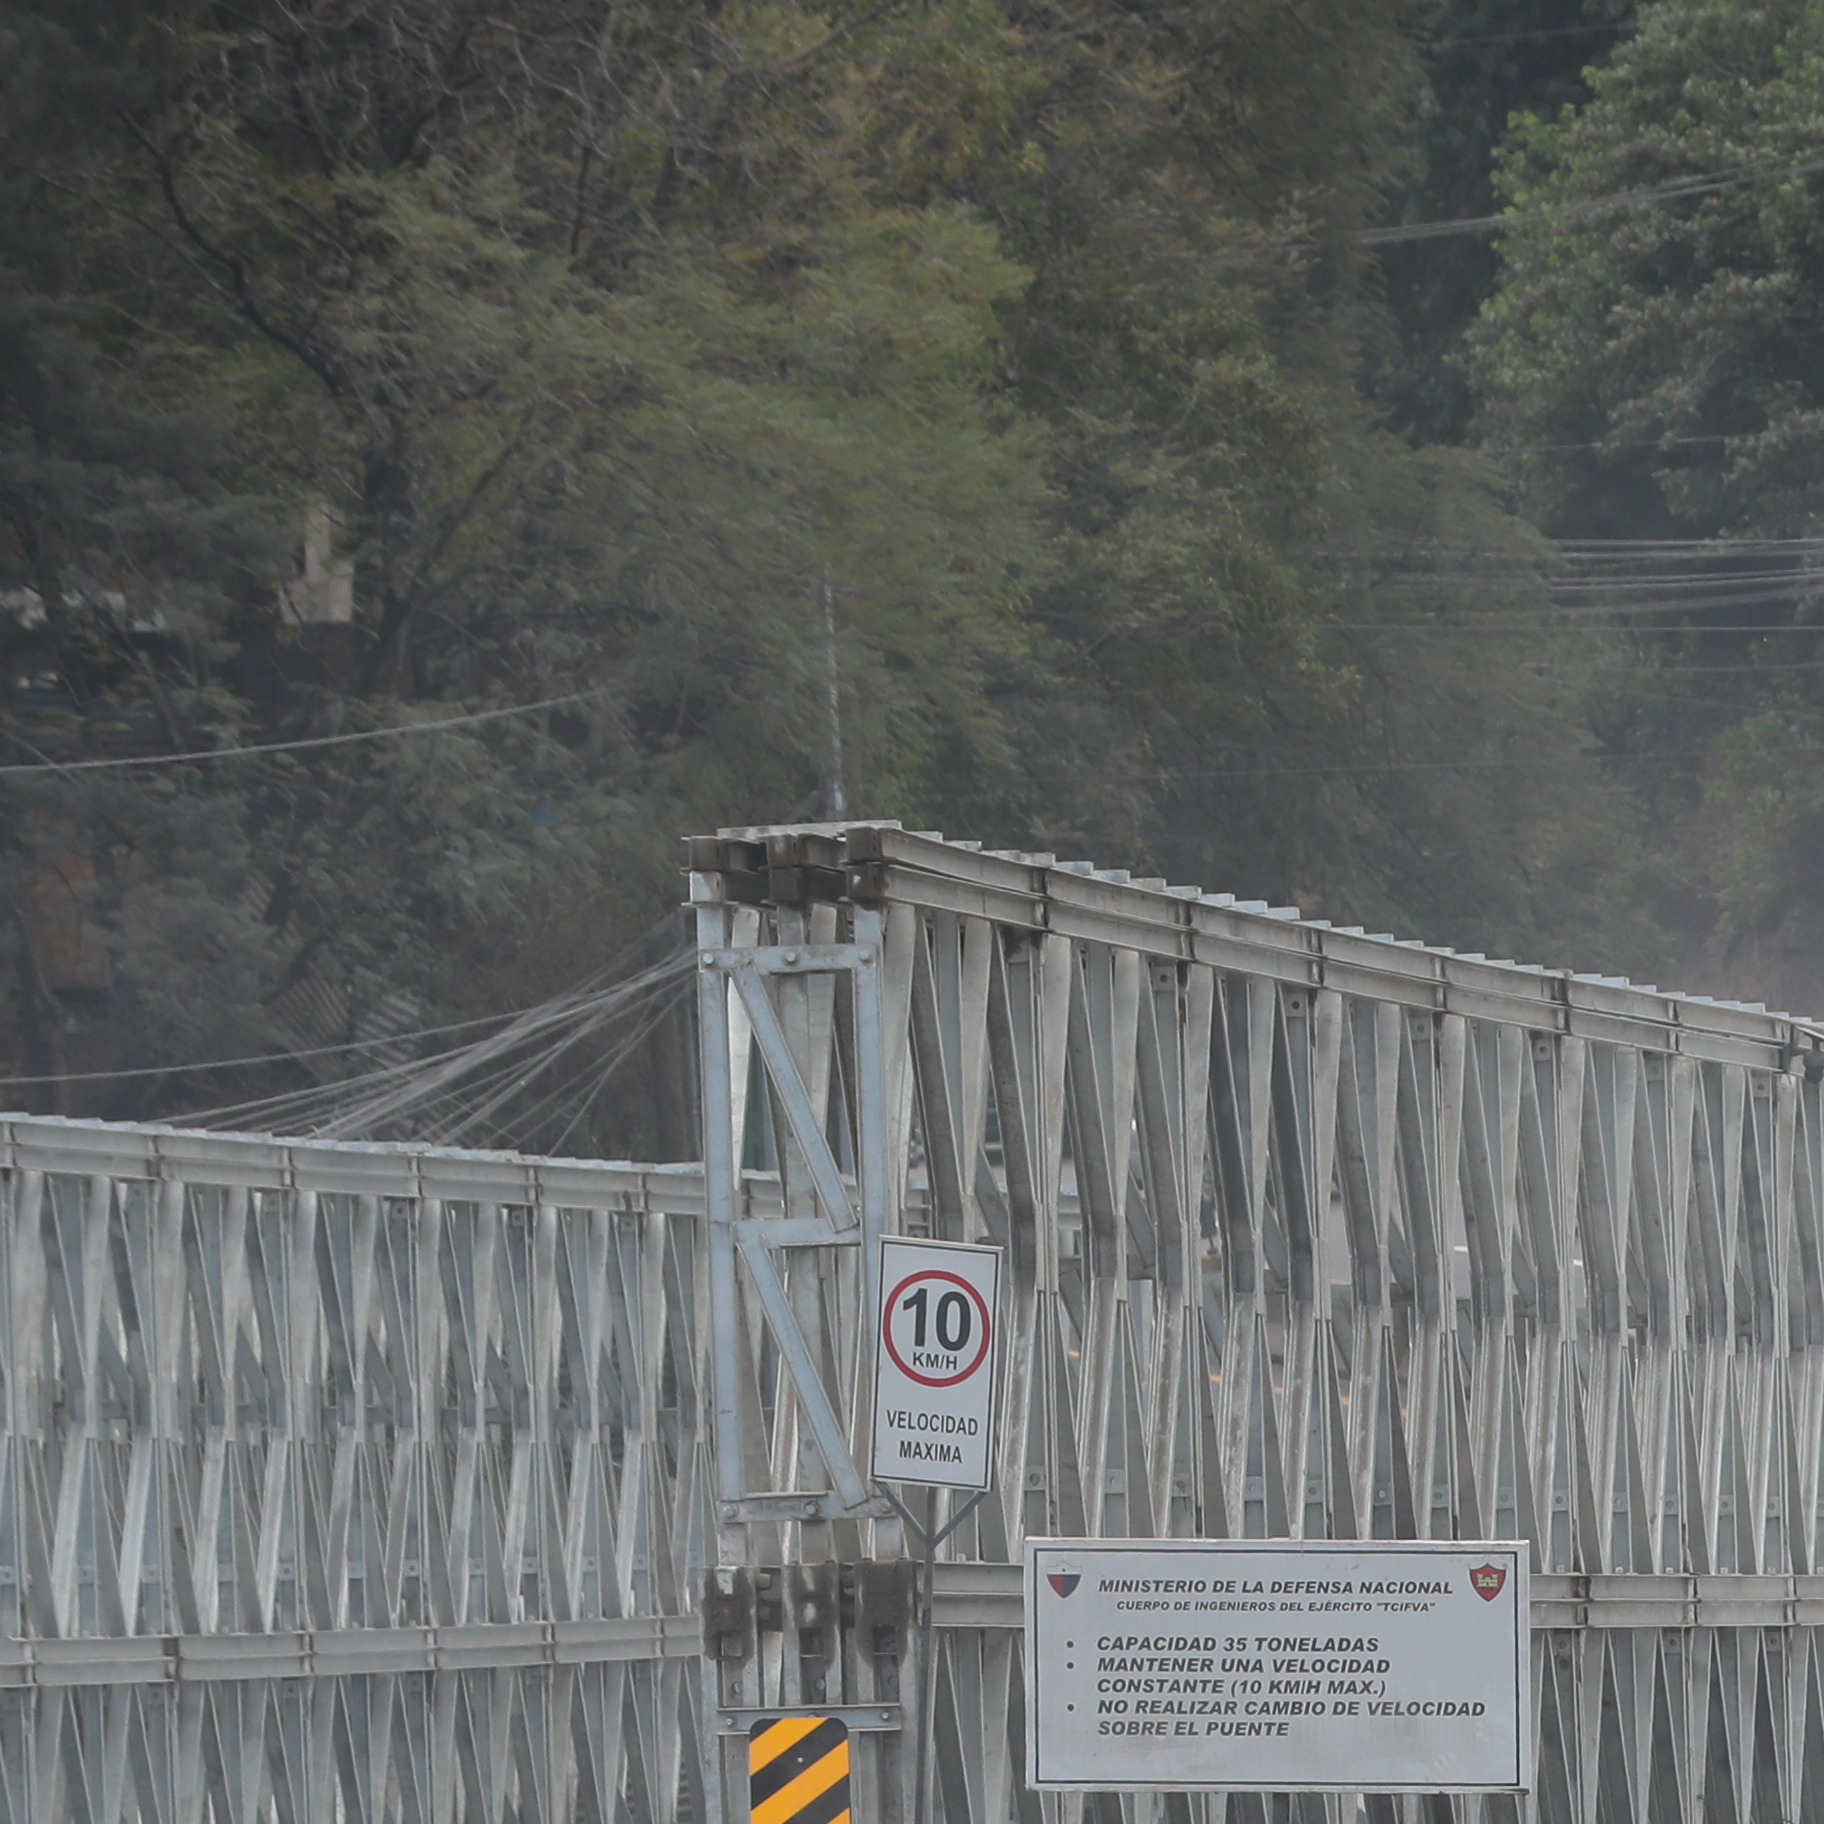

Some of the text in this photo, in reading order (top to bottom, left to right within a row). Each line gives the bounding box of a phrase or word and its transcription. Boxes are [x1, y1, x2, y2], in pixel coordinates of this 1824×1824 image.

[903, 1288, 971, 1351] 10
[912, 1352, 957, 1370] KM/H
[886, 1409, 978, 1436] VELOCIDAD
[899, 1440, 963, 1464] MAXIMA
[1098, 1579, 1453, 1595] MINISTERIO DE LA DEFENSA NACIONAL
[1116, 1600, 1170, 1611] CUERPO
[1174, 1601, 1191, 1611] DE
[1195, 1601, 1275, 1612] INGENIEROS
[1279, 1601, 1304, 1612] DEL
[1308, 1599, 1373, 1612] EJÉRCITO
[1097, 1636, 1379, 1653] CAPACIDAD 35 TONELADAS
[1097, 1657, 1391, 1674] MANTENER UNA VELOCIDAD
[1097, 1678, 1225, 1694] CONSTANTE
[1230, 1679, 1262, 1698] (10
[1327, 1680, 1386, 1698] MAX.)
[1097, 1699, 1486, 1717] NO REALIZAR CAMBIO DE VELOCIDAD
[1097, 1720, 1290, 1737] SOBRE EL PUENTE
